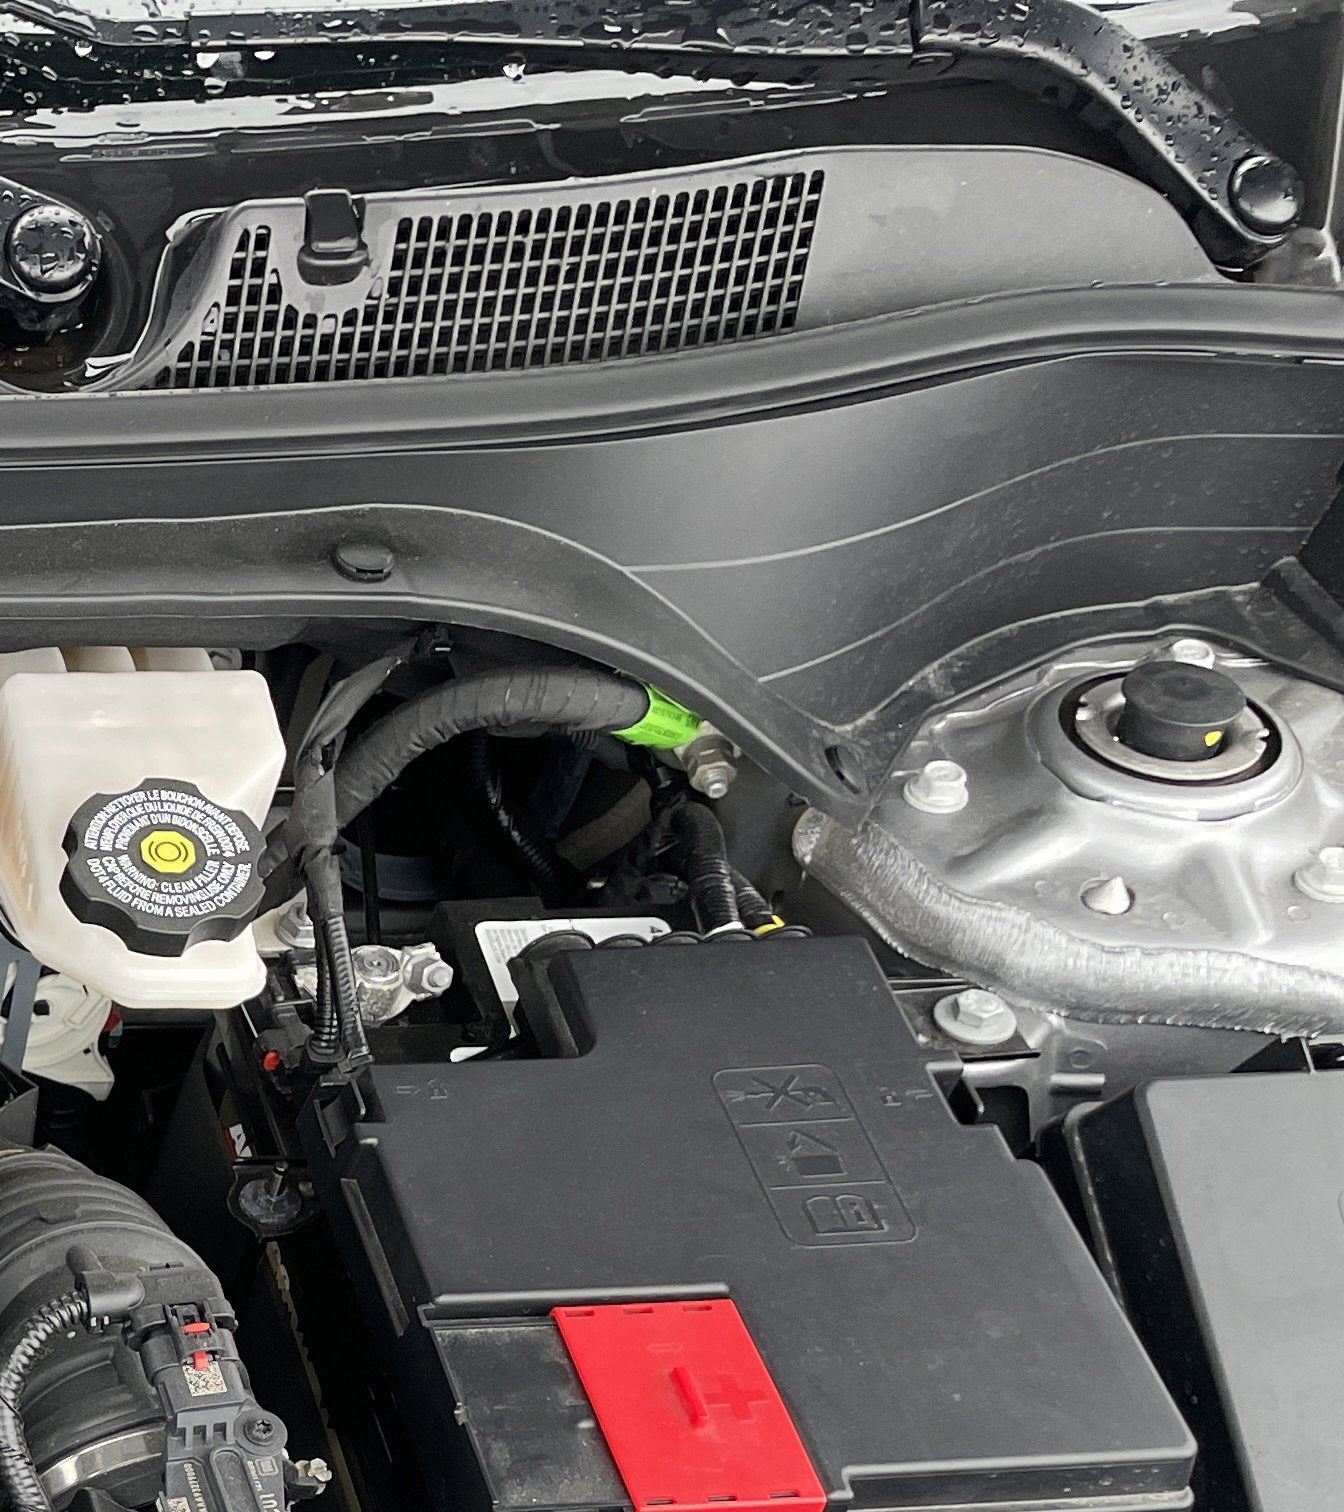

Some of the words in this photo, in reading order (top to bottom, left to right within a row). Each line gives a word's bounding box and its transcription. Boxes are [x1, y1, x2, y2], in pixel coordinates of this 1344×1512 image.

[102, 856, 121, 874] CAP
[113, 872, 153, 900] BEFORE
[216, 861, 235, 884] ONLY
[160, 879, 198, 893] CLEAN
[194, 859, 220, 887] FILLER
[102, 879, 132, 903] FLUID
[131, 897, 164, 916] FROM
[165, 906, 173, 917] A
[175, 901, 216, 917] SEALED
